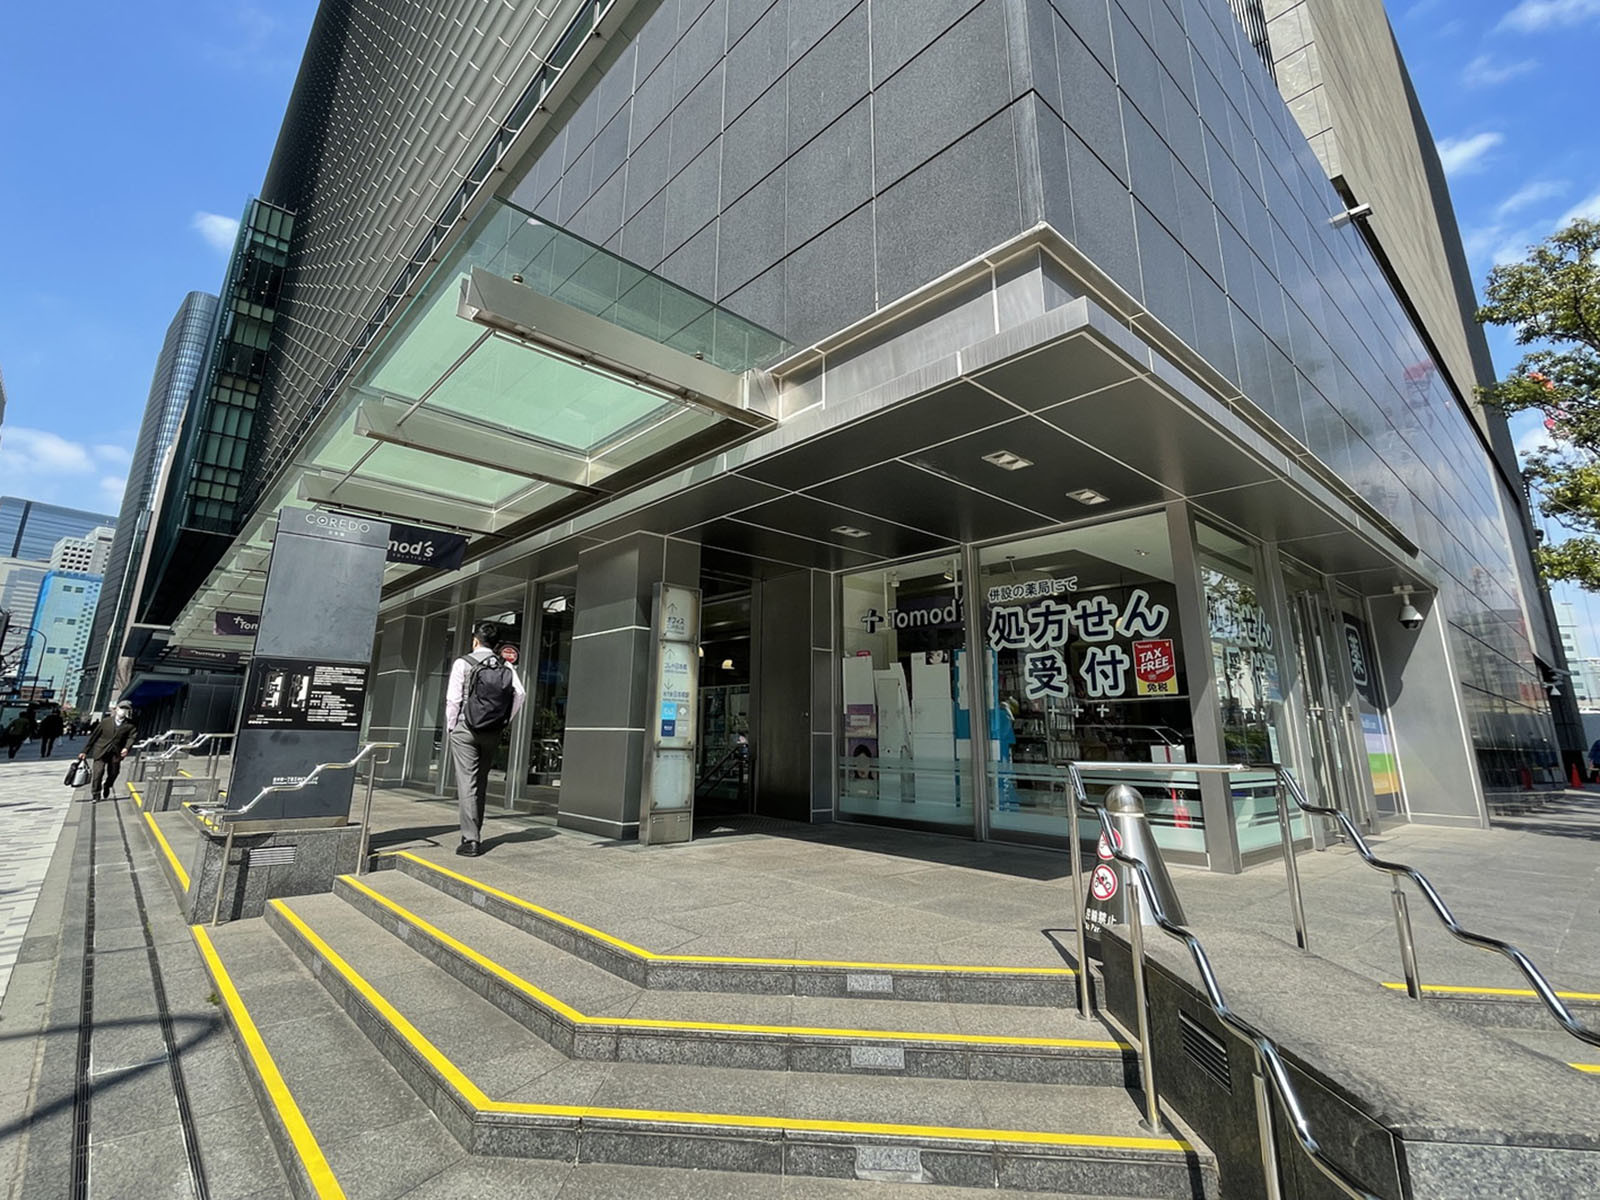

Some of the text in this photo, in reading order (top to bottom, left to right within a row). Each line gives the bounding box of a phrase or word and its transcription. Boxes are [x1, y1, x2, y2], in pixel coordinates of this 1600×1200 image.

[305, 513, 370, 533] COREDO
[387, 540, 435, 557] mod's
[988, 575, 1078, 603] 併設の薬局にて
[988, 588, 1169, 649] 処方せん
[1139, 647, 1162, 663] TAX
[1140, 656, 1169, 674] FREE
[1023, 643, 1131, 699] 受付
